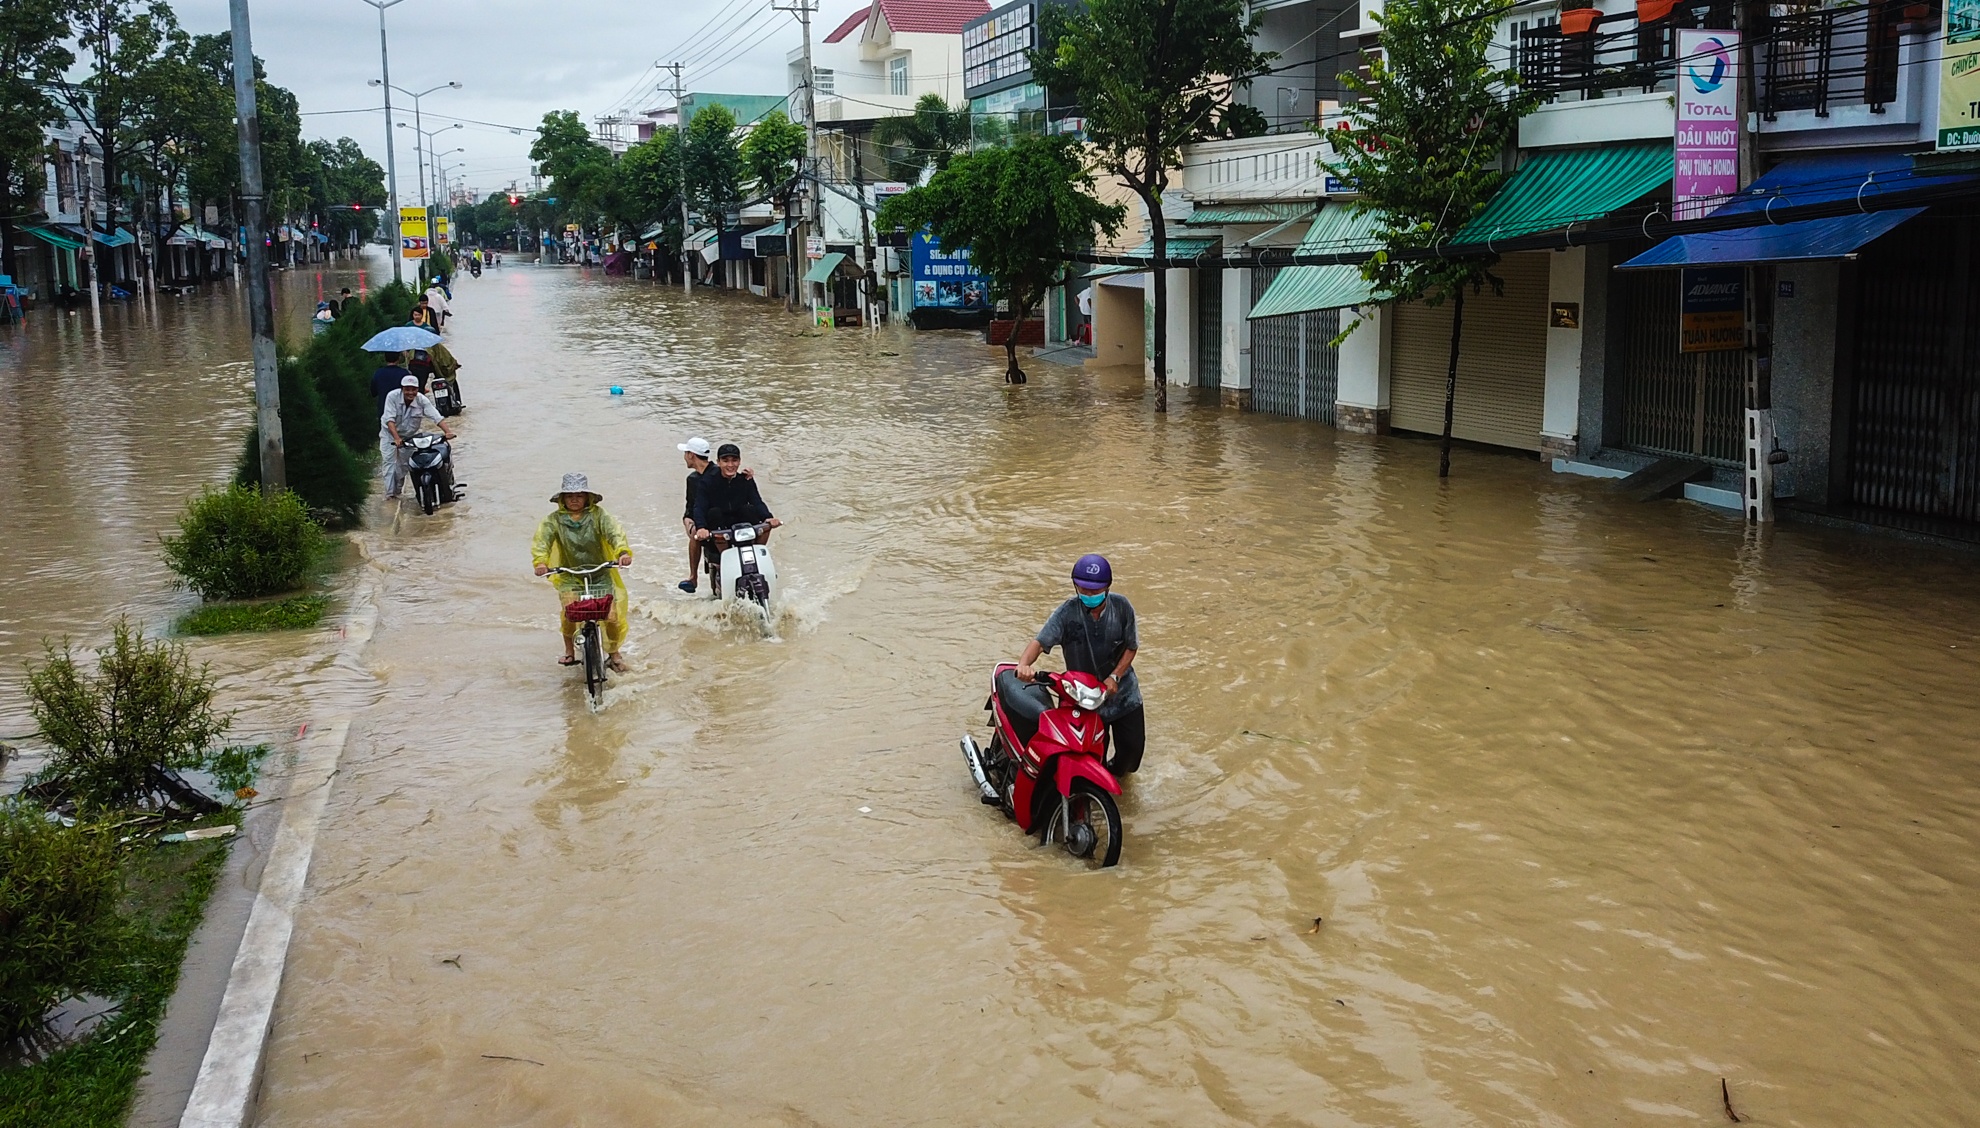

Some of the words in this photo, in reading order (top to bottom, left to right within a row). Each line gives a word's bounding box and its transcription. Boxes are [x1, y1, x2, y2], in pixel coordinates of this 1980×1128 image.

[1684, 102, 1732, 116] TOTAL
[1678, 124, 1702, 145] DẦU
[1705, 127, 1736, 145] NHỚT
[1678, 159, 1693, 180] PHỤ
[1713, 159, 1735, 176] HONDA
[924, 265, 931, 275] &
[932, 265, 953, 277] DỤNG
[954, 265, 965, 277] CỤ
[1688, 283, 1740, 296] ADVANCE
